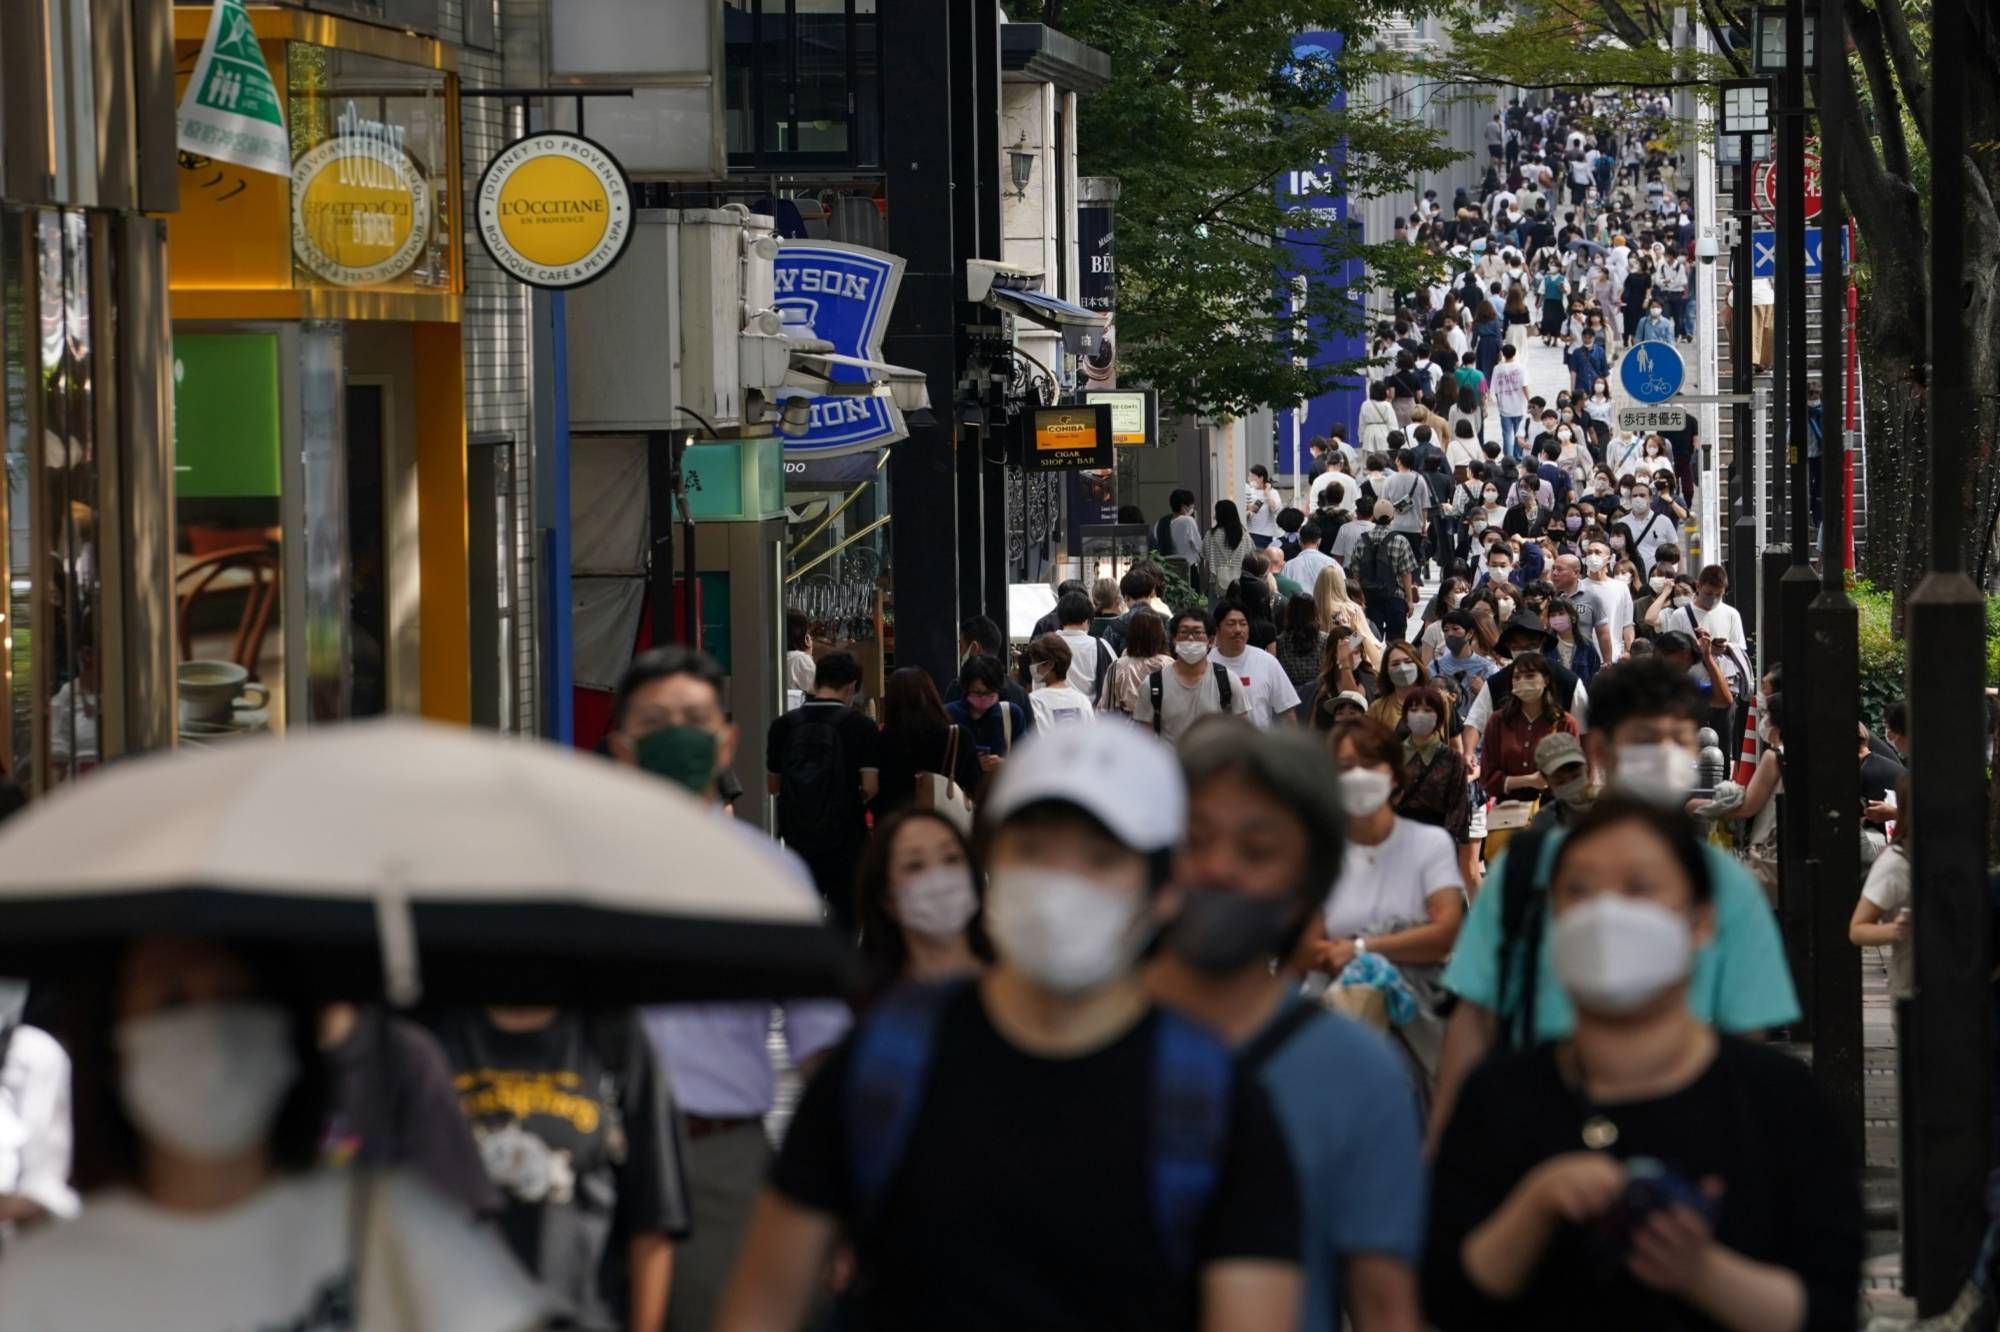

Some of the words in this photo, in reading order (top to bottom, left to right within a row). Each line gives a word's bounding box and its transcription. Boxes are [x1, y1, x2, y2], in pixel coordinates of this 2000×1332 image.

[483, 145, 528, 202] JOURNEY
[535, 140, 555, 150] TO
[561, 141, 622, 197] PROVENCE
[502, 198, 604, 215] L'OCCITANE
[521, 217, 532, 225] EN
[536, 216, 584, 225] PROVENCE
[486, 224, 535, 277] BOUTIQUE
[538, 268, 571, 281] CAFÉ
[574, 268, 582, 277] &
[584, 245, 611, 271] PETIT
[609, 220, 622, 241] SPA
[1624, 412, 1682, 426] 歩行者優先
[1048, 424, 1084, 433] COHIBA
[1055, 450, 1080, 458] CIGAR
[1040, 458, 1064, 466] SHOP
[1077, 457, 1095, 466] BAR
[783, 463, 806, 473] DO
